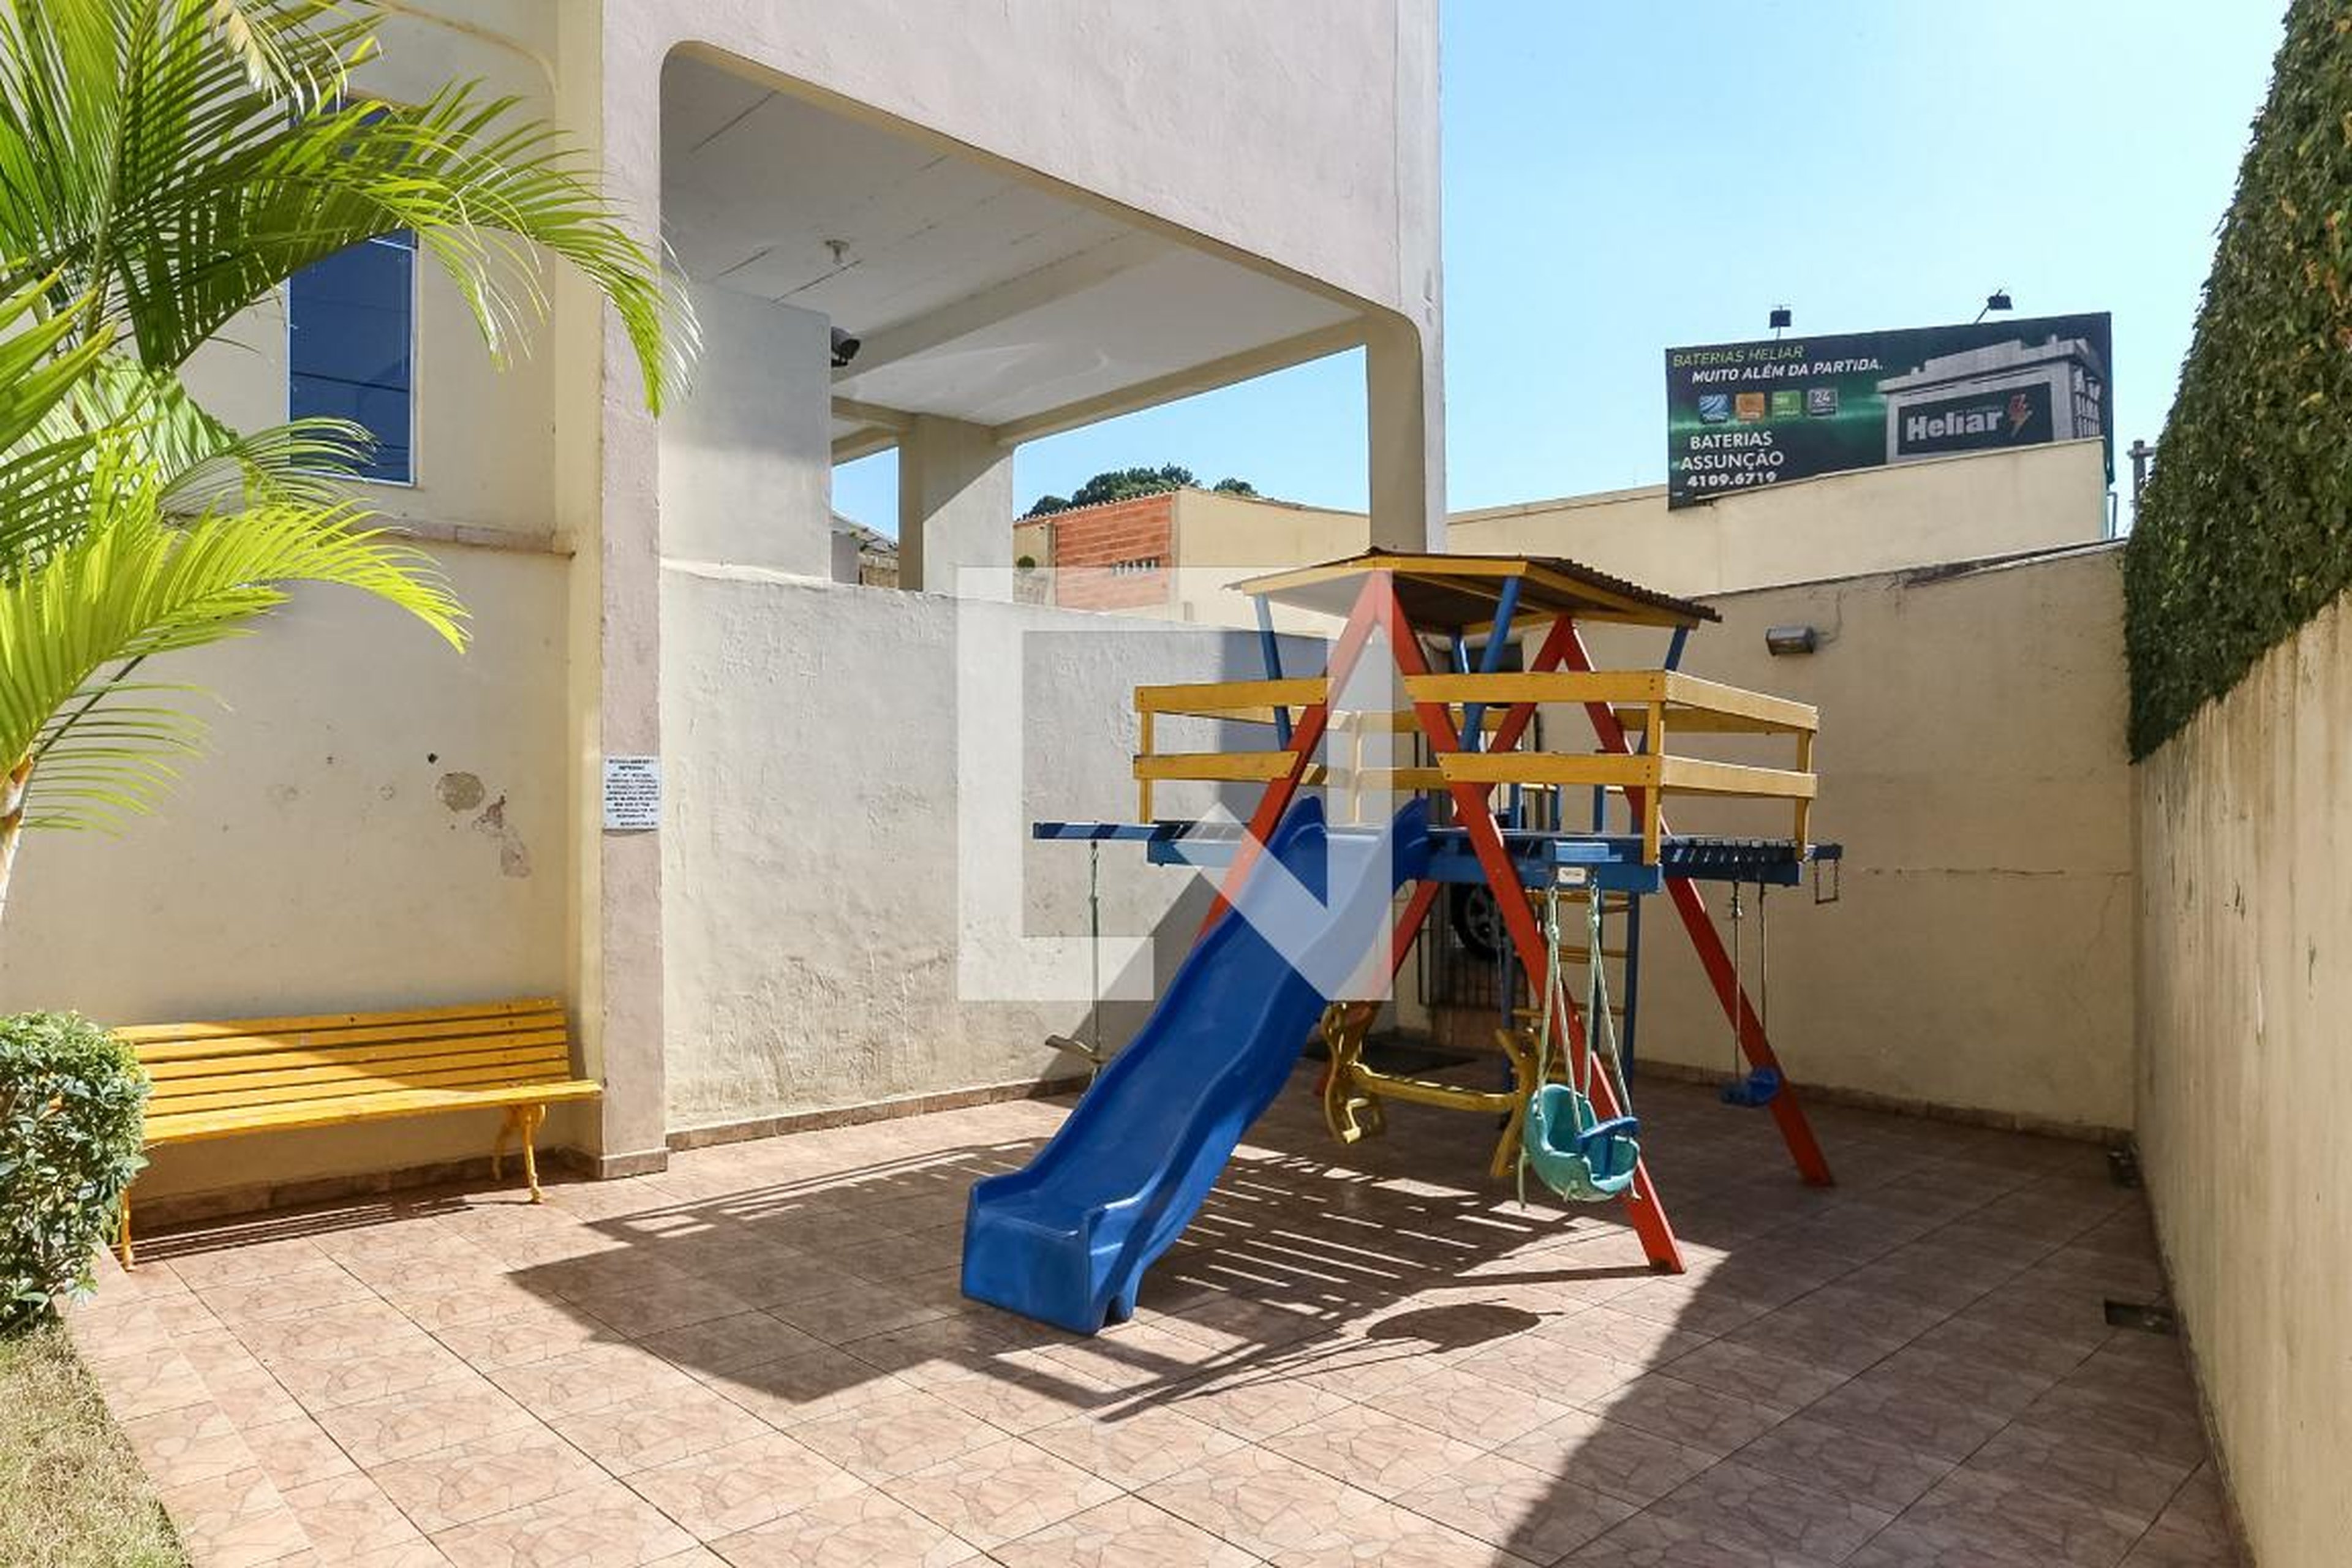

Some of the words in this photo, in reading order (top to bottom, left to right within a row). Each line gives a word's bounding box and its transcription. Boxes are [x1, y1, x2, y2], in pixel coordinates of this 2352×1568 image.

[1673, 350, 1744, 368] BATERIAS
[1748, 345, 1804, 362] HELIAR
[1692, 368, 1739, 385] MUITO
[1788, 363, 1808, 377] DA
[1812, 358, 1883, 375] PARTIDA.
[1907, 410, 2003, 442] Heliar
[1691, 431, 1773, 450] BATERIAS
[1680, 448, 1784, 471] ASSUNÇÃO
